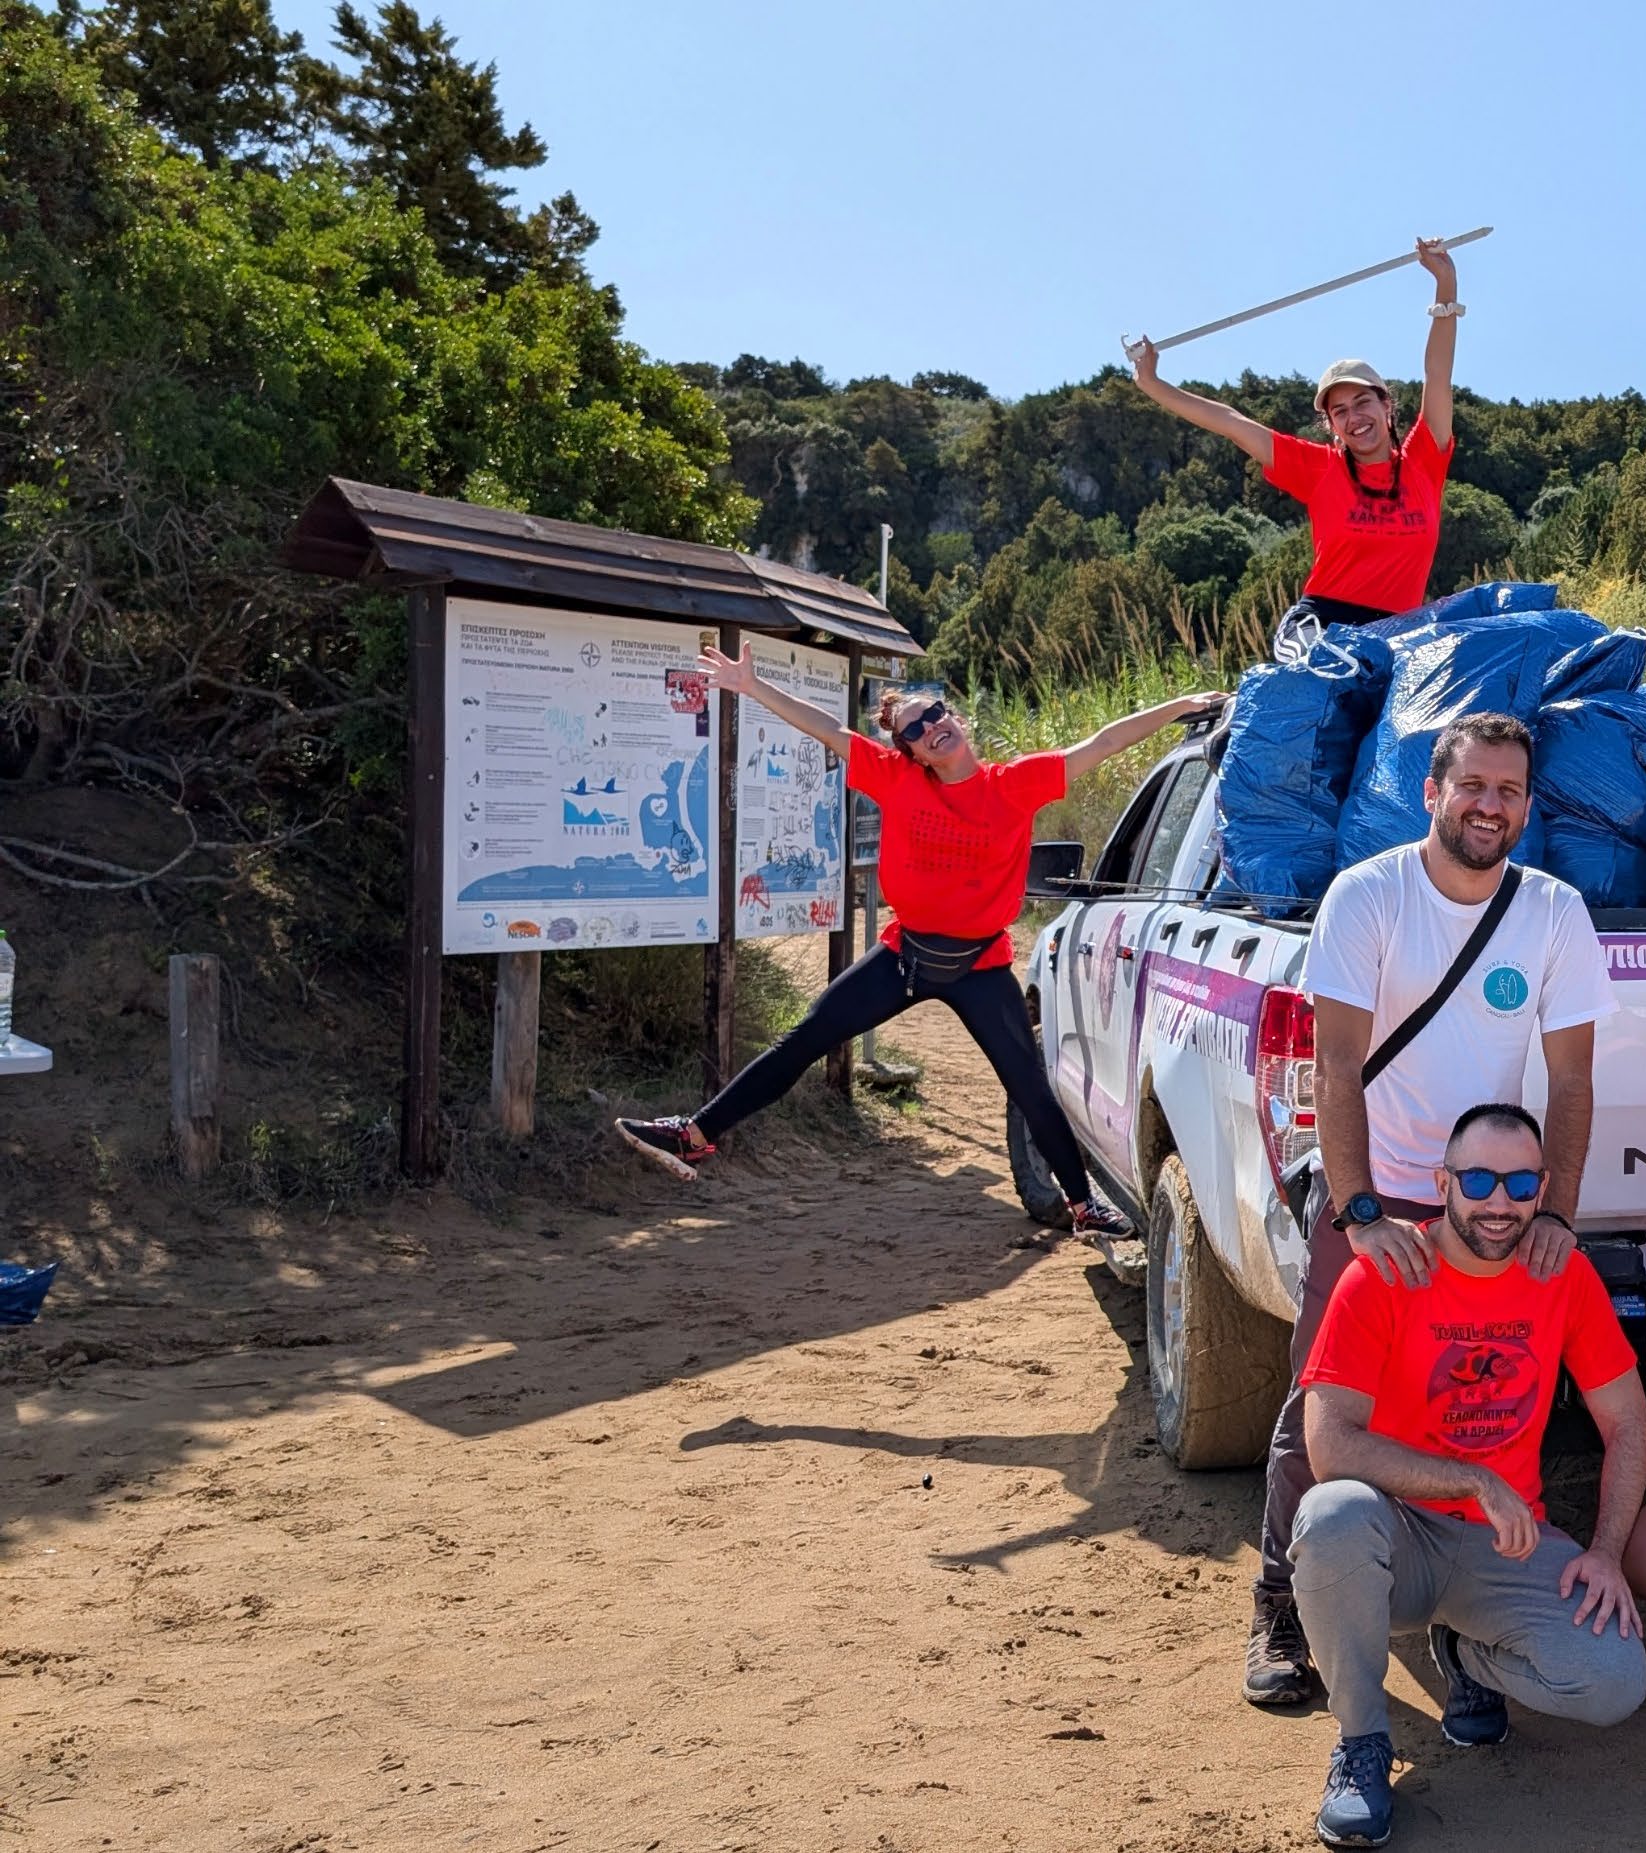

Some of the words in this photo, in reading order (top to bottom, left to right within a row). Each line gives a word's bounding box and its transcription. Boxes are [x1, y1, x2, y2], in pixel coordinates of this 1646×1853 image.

[611, 640, 649, 650] ATTENTION
[650, 643, 680, 653] VISITORS
[611, 648, 634, 656] PLEASE
[635, 650, 660, 659] PROTECT
[563, 826, 606, 837] NATURA
[1483, 960, 1500, 973] SURF
[1511, 960, 1528, 974] YOGA
